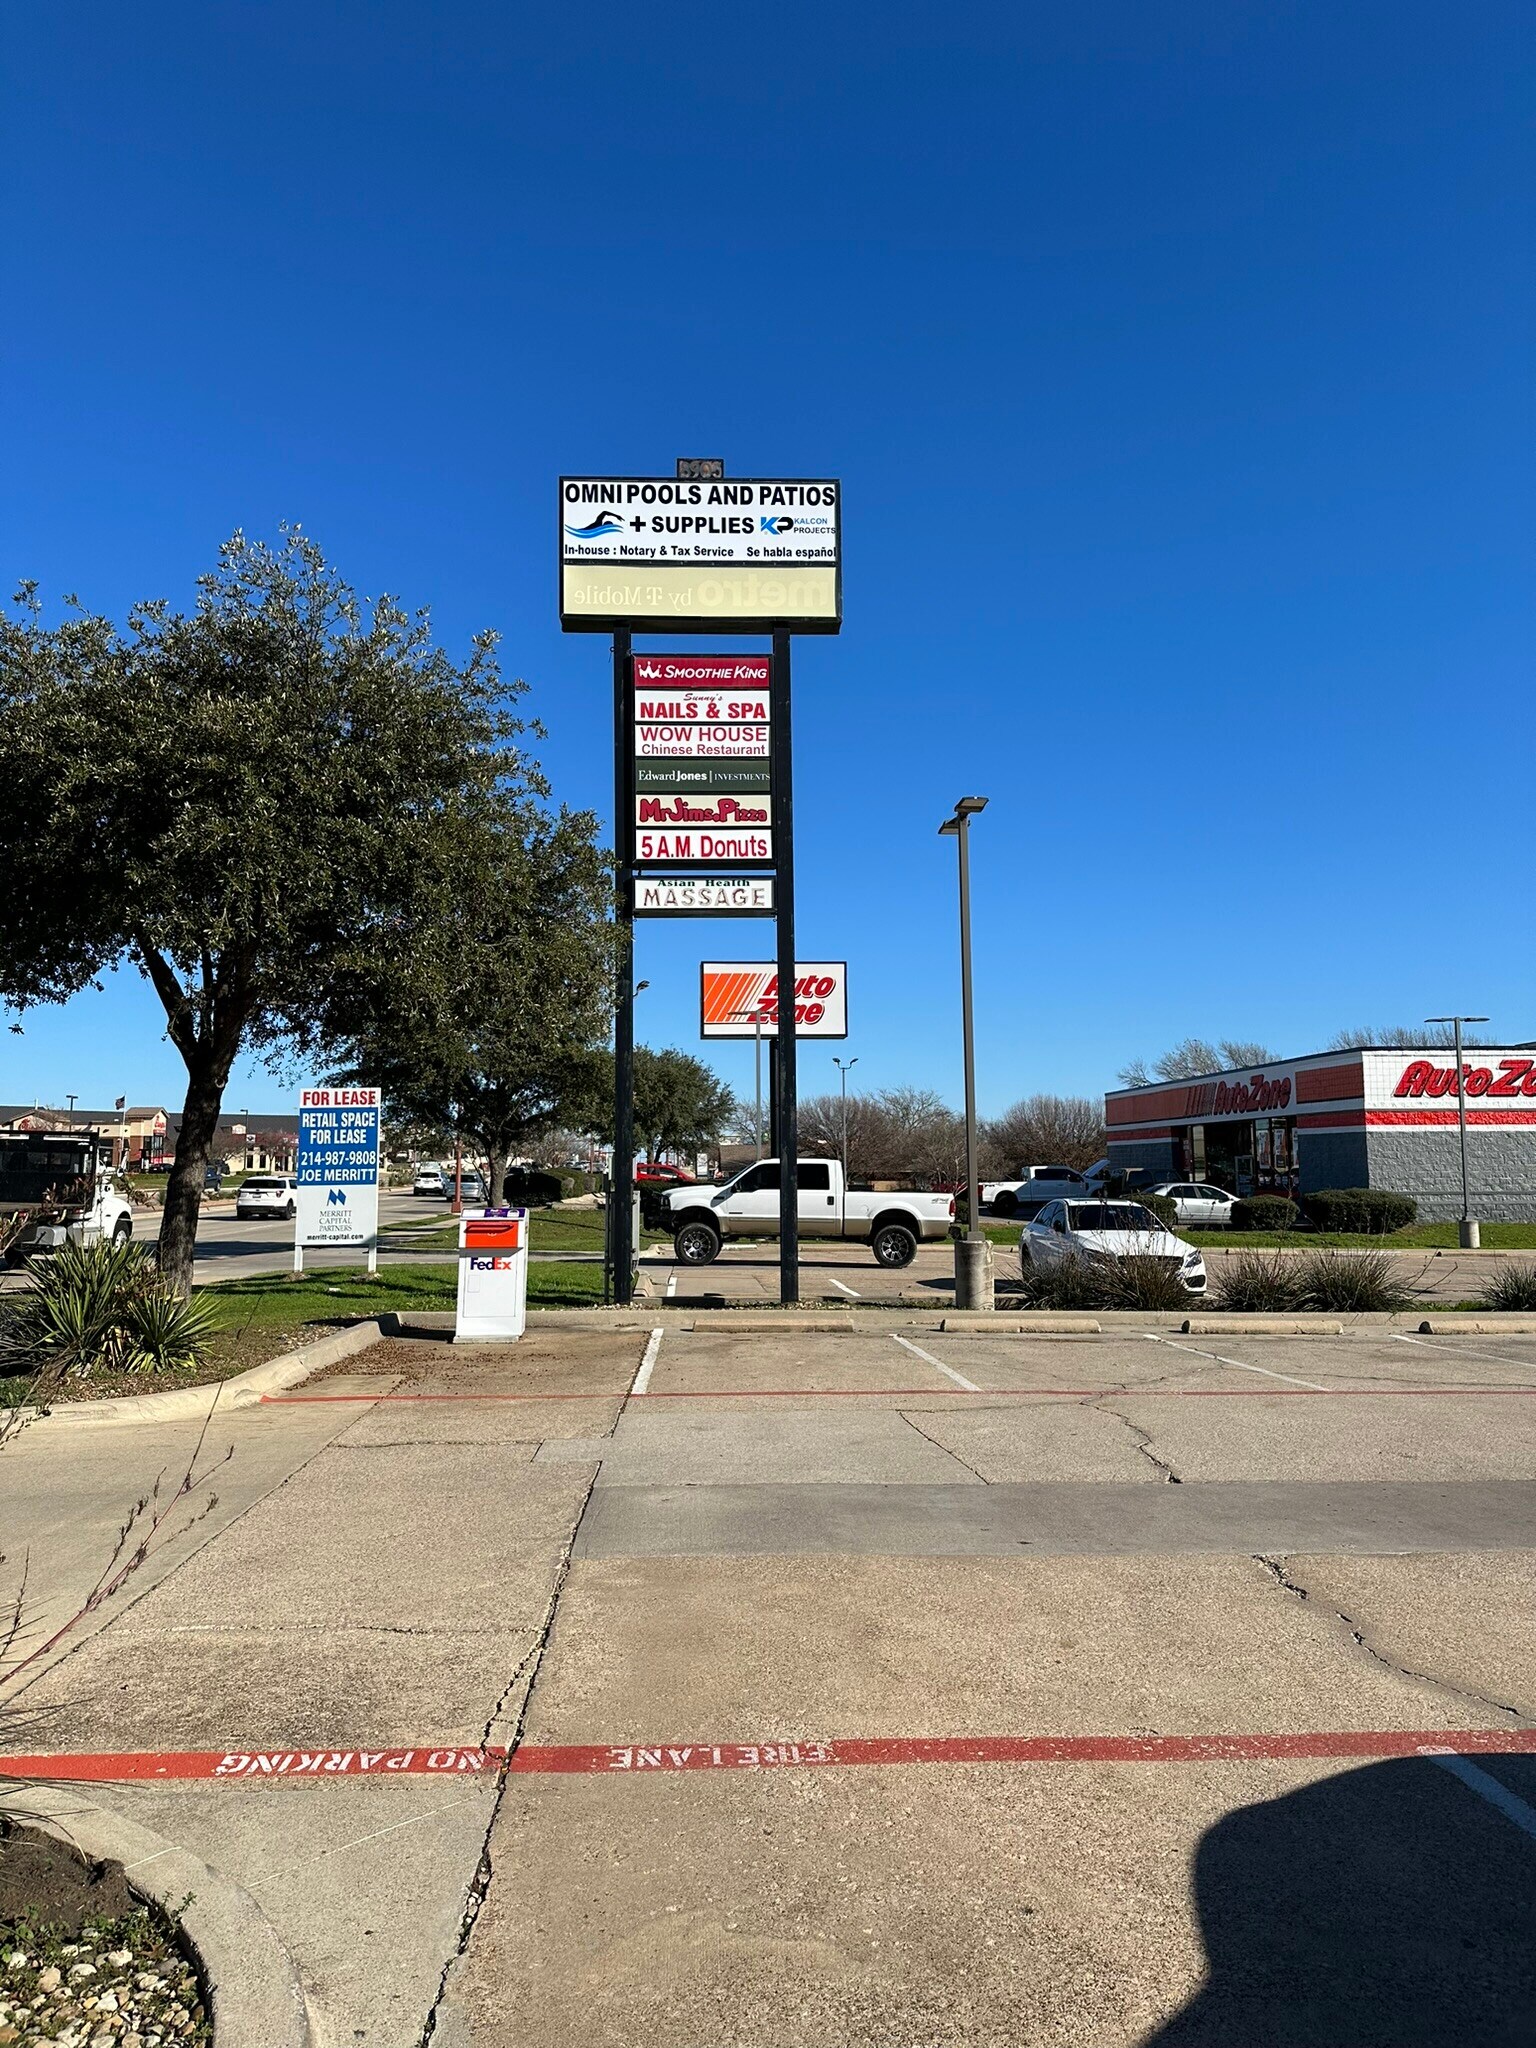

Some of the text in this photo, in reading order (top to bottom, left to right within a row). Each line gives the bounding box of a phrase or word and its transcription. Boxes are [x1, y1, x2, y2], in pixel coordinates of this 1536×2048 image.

[565, 483, 835, 506] OMNI POOLS AND PATIOS
[651, 516, 754, 533] SUPPLIES
[620, 545, 656, 558] Notary
[660, 545, 668, 556] &
[671, 546, 690, 556] Tax
[694, 546, 734, 557] Service
[747, 546, 836, 559] Se habla español
[664, 665, 732, 679] SMOOTHIE
[683, 693, 723, 702] Sunny's
[640, 702, 766, 718] NAILS & SPA
[640, 727, 767, 741] WOW HOUSE
[642, 744, 765, 755] Chinese Restaurant
[641, 836, 767, 858] 5 A.M. Donuts
[658, 879, 750, 887] Asian Health
[644, 888, 765, 907] MASSAGE
[303, 1091, 376, 1106] FOR LEASE
[1214, 1074, 1291, 1116] AutoZone
[302, 1112, 375, 1128] RETAIL SPACE
[310, 1129, 366, 1144] FOR LEASE
[301, 1151, 376, 1166] 214-987-9808
[299, 1168, 375, 1182] JOE MERRITT
[470, 1256, 512, 1270] FedEx
[214, 1749, 485, 1776] NO PARKING
[608, 1746, 724, 1768] LANE
